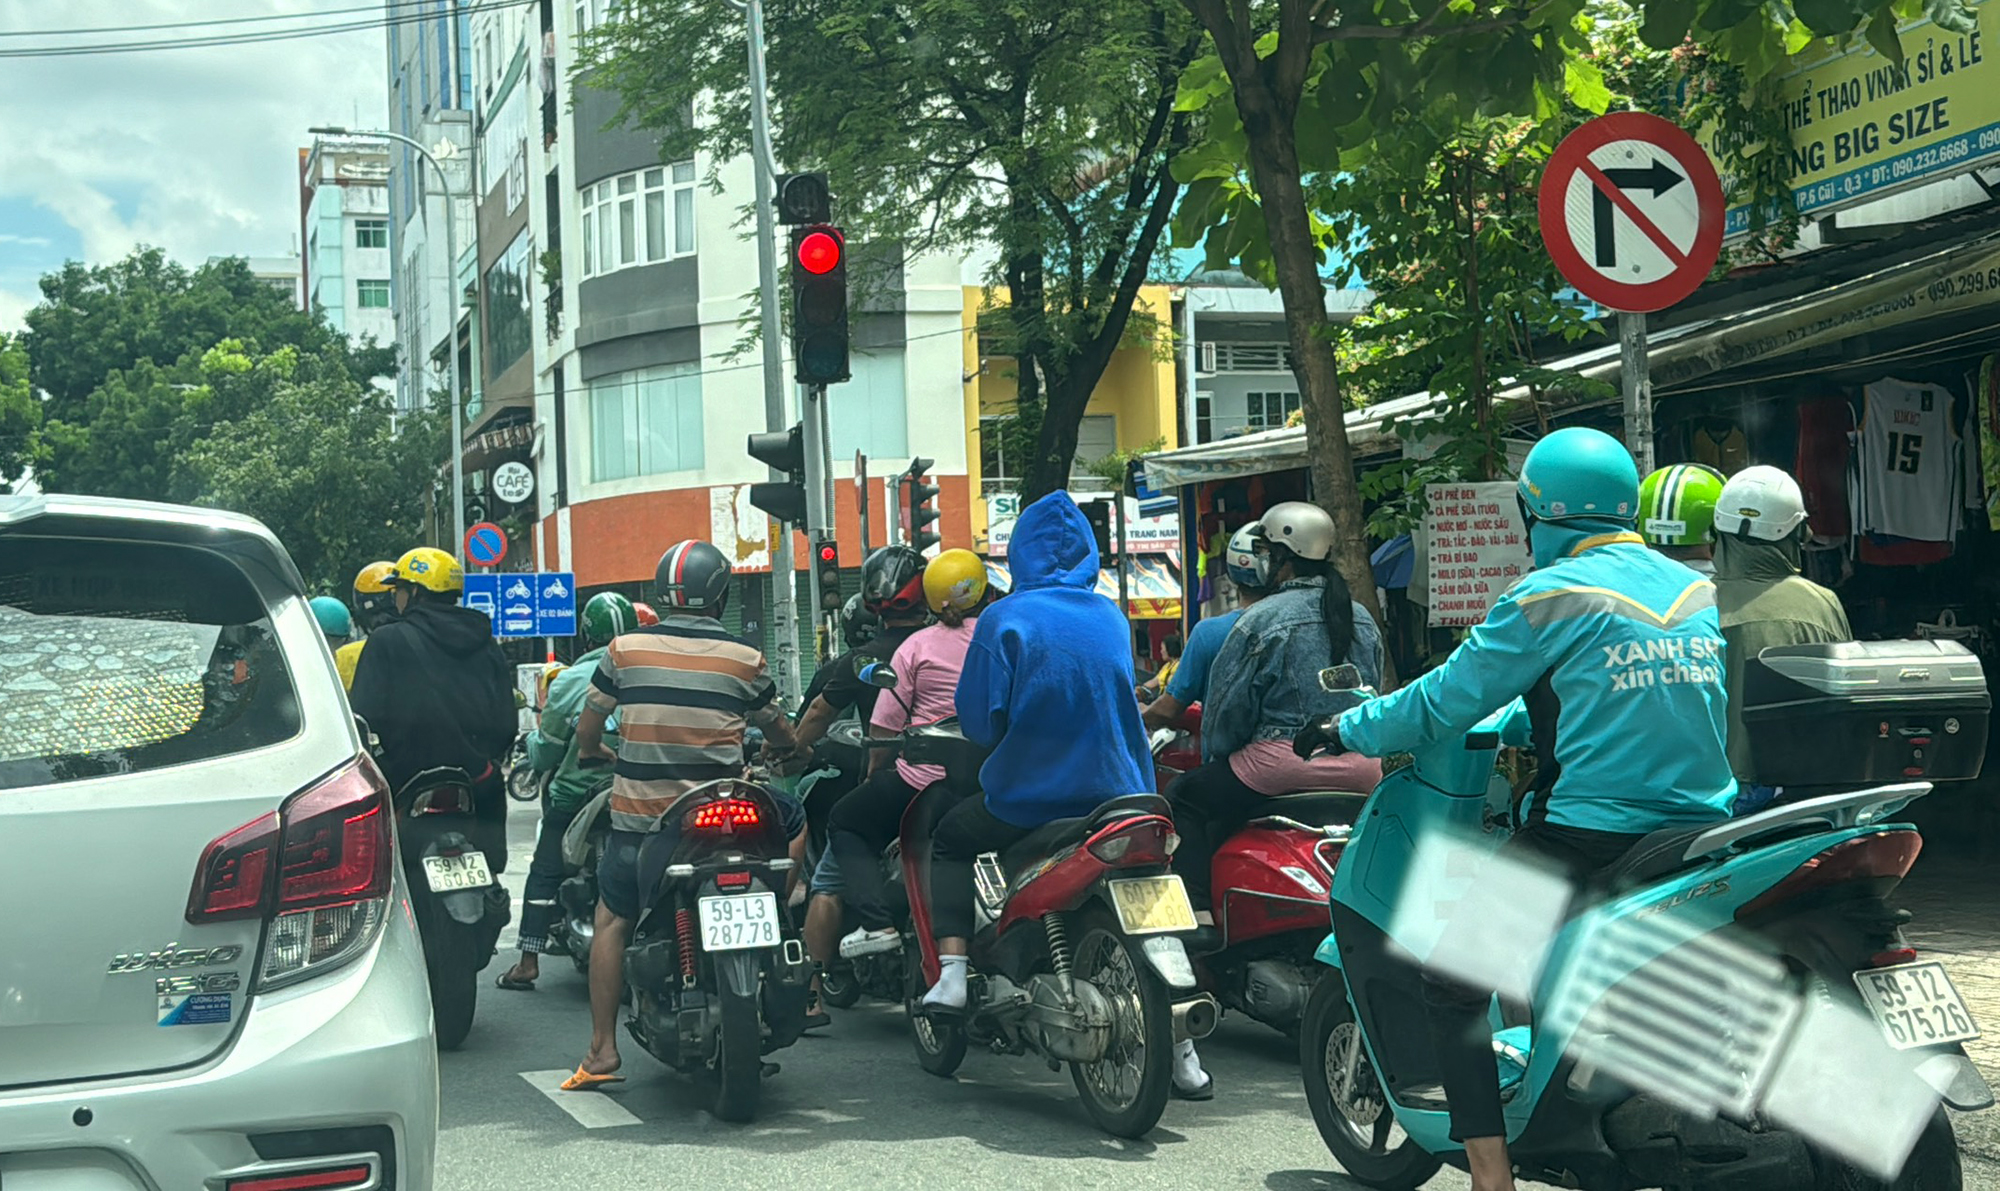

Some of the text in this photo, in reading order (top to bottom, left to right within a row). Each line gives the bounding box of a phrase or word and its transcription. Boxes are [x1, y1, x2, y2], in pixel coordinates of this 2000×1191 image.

[1817, 77, 1861, 119] THAO
[1917, 38, 1934, 84] SỈ
[1940, 43, 1954, 75] &
[1834, 122, 1880, 164] BIG
[1888, 96, 1950, 146] SIZE
[1844, 174, 1861, 194] Q.3
[1892, 138, 1968, 178] 090.232.6668
[1887, 431, 1923, 475] 15
[497, 472, 530, 488] CAFÉ
[1435, 504, 1444, 516] CÀ
[1445, 503, 1459, 516] PHÊ
[1461, 502, 1476, 515] SỮA
[1129, 529, 1157, 538] TRANG
[1160, 528, 1178, 537] NAM
[1480, 566, 1502, 578] CACAO
[1438, 600, 1464, 611] CHANH
[1602, 637, 1684, 668] XANH
[1610, 660, 1717, 692] xin chào
[434, 856, 478, 873] 59-V2
[711, 898, 765, 922] 59-L3
[708, 921, 773, 947] 287.78
[1870, 969, 1946, 1007] 59-T2
[1884, 1002, 1970, 1043] 675.26
